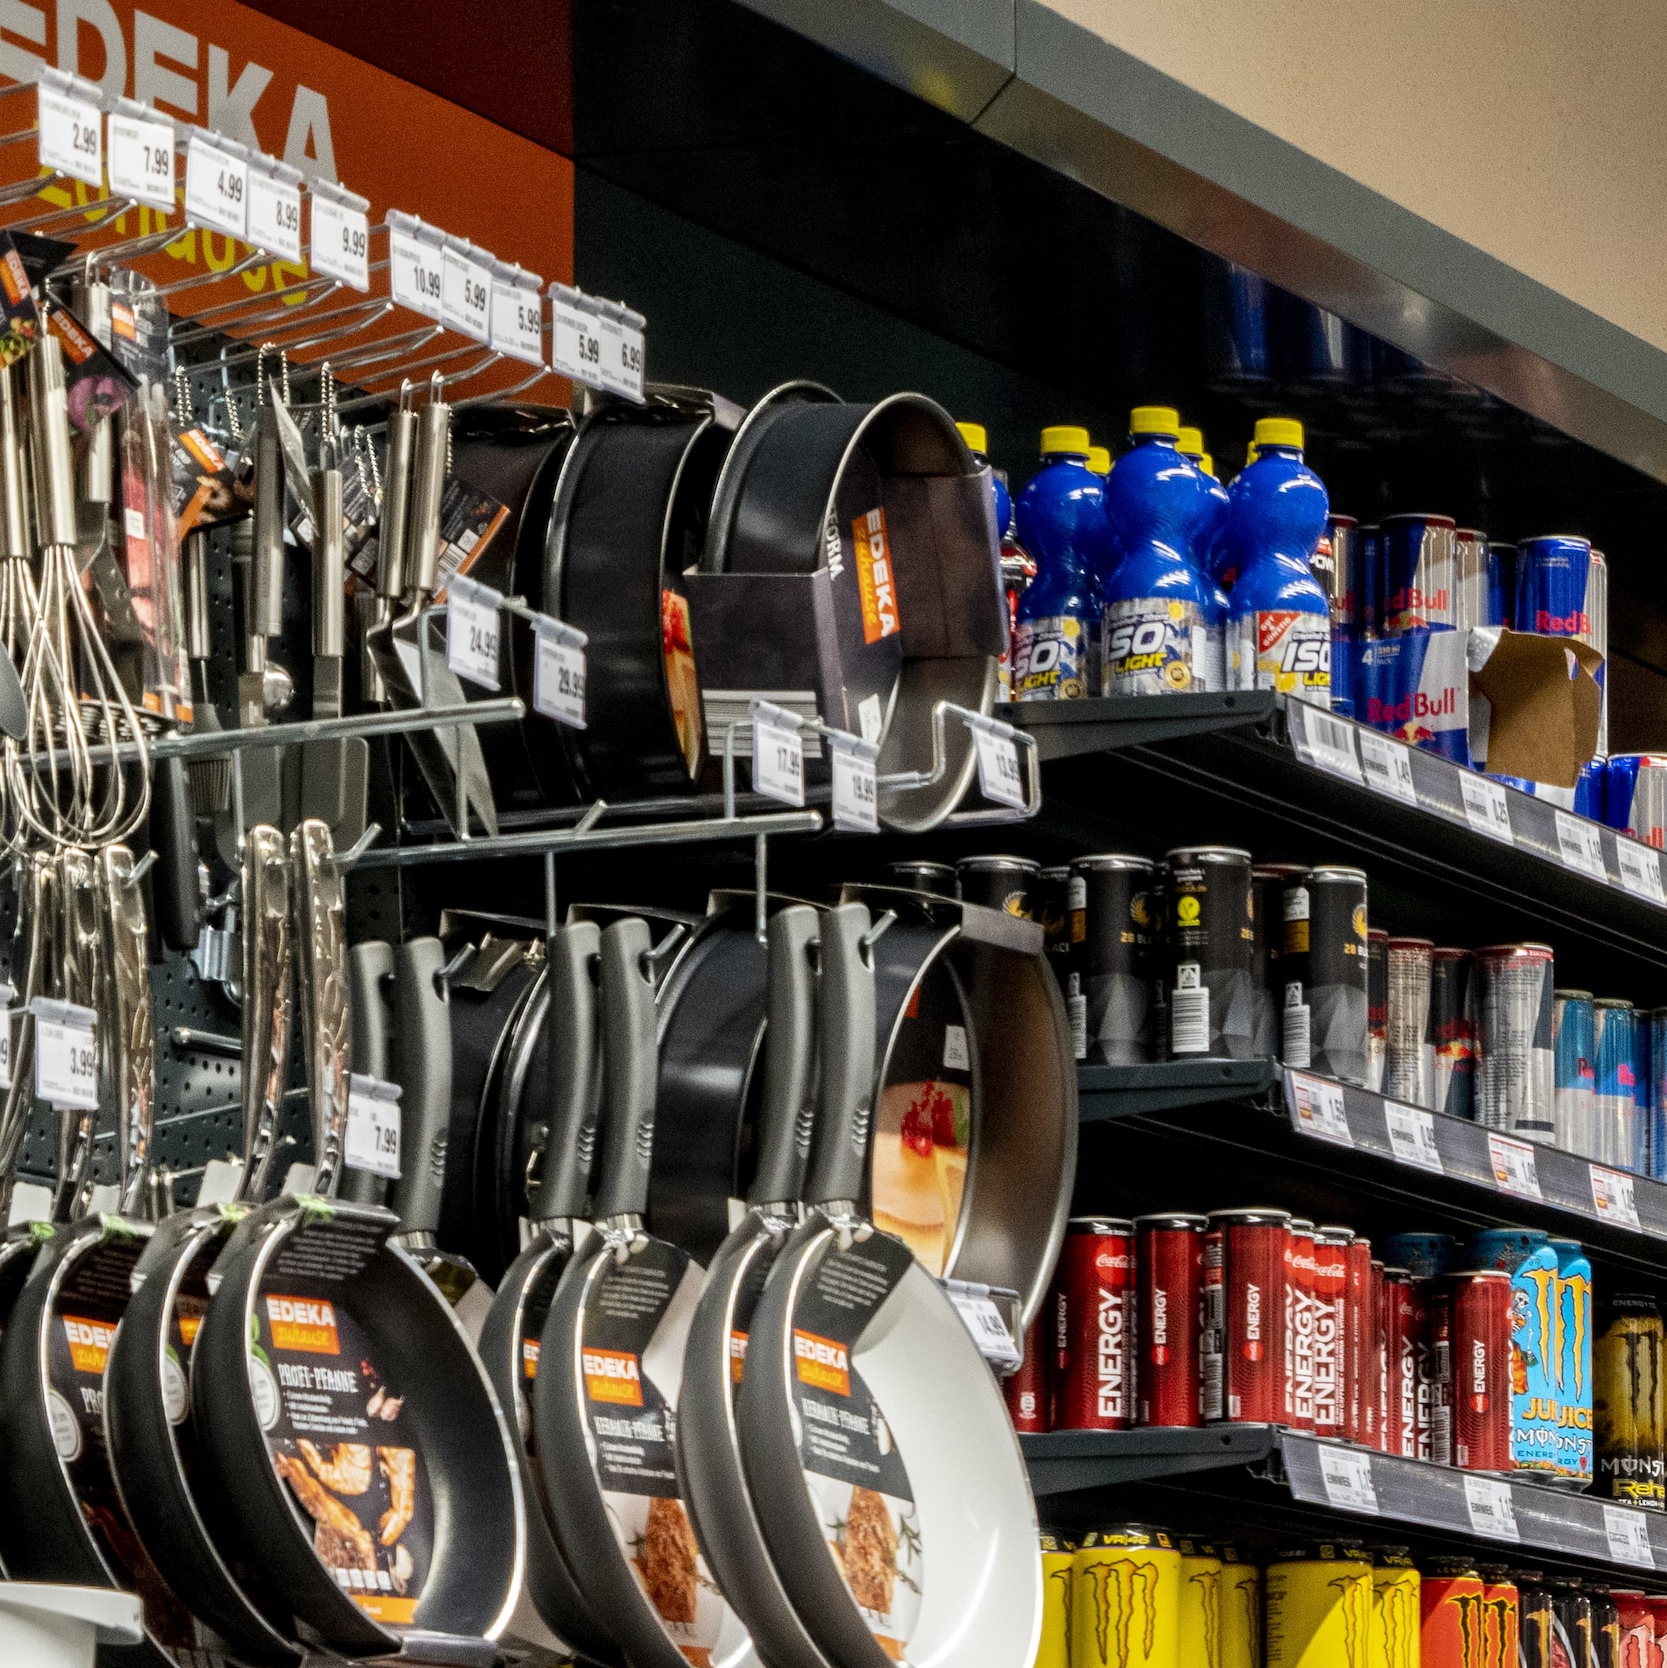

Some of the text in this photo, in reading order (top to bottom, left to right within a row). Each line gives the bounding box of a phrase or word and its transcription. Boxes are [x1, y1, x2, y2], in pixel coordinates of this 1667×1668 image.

[0, 0, 339, 184] EDEKA
[73, 123, 96, 156] 2.99
[144, 146, 169, 176] 7.99
[217, 170, 243, 202] 4.99
[276, 200, 298, 232] 8.99
[342, 226, 366, 258] 9.99
[414, 267, 440, 299] 10.99
[464, 278, 486, 312] 5.99
[518, 306, 540, 335] 5.99
[578, 334, 600, 364] 5.99
[621, 343, 641, 373] 6.99
[865, 507, 896, 638] EDEKA
[1367, 687, 1455, 724] Red Bull
[375, 1126, 397, 1156] 7.99
[268, 1298, 336, 1328] EDEKA
[1156, 1288, 1167, 1345] ENERGY
[1248, 1283, 1260, 1340] ENERGY
[583, 1354, 640, 1380] EDEKA
[795, 1336, 849, 1372] EDEKA
[1099, 1289, 1122, 1417] ENERGY
[1315, 1299, 1336, 1425] ENERGY
[1474, 1340, 1486, 1393] ENERGY
